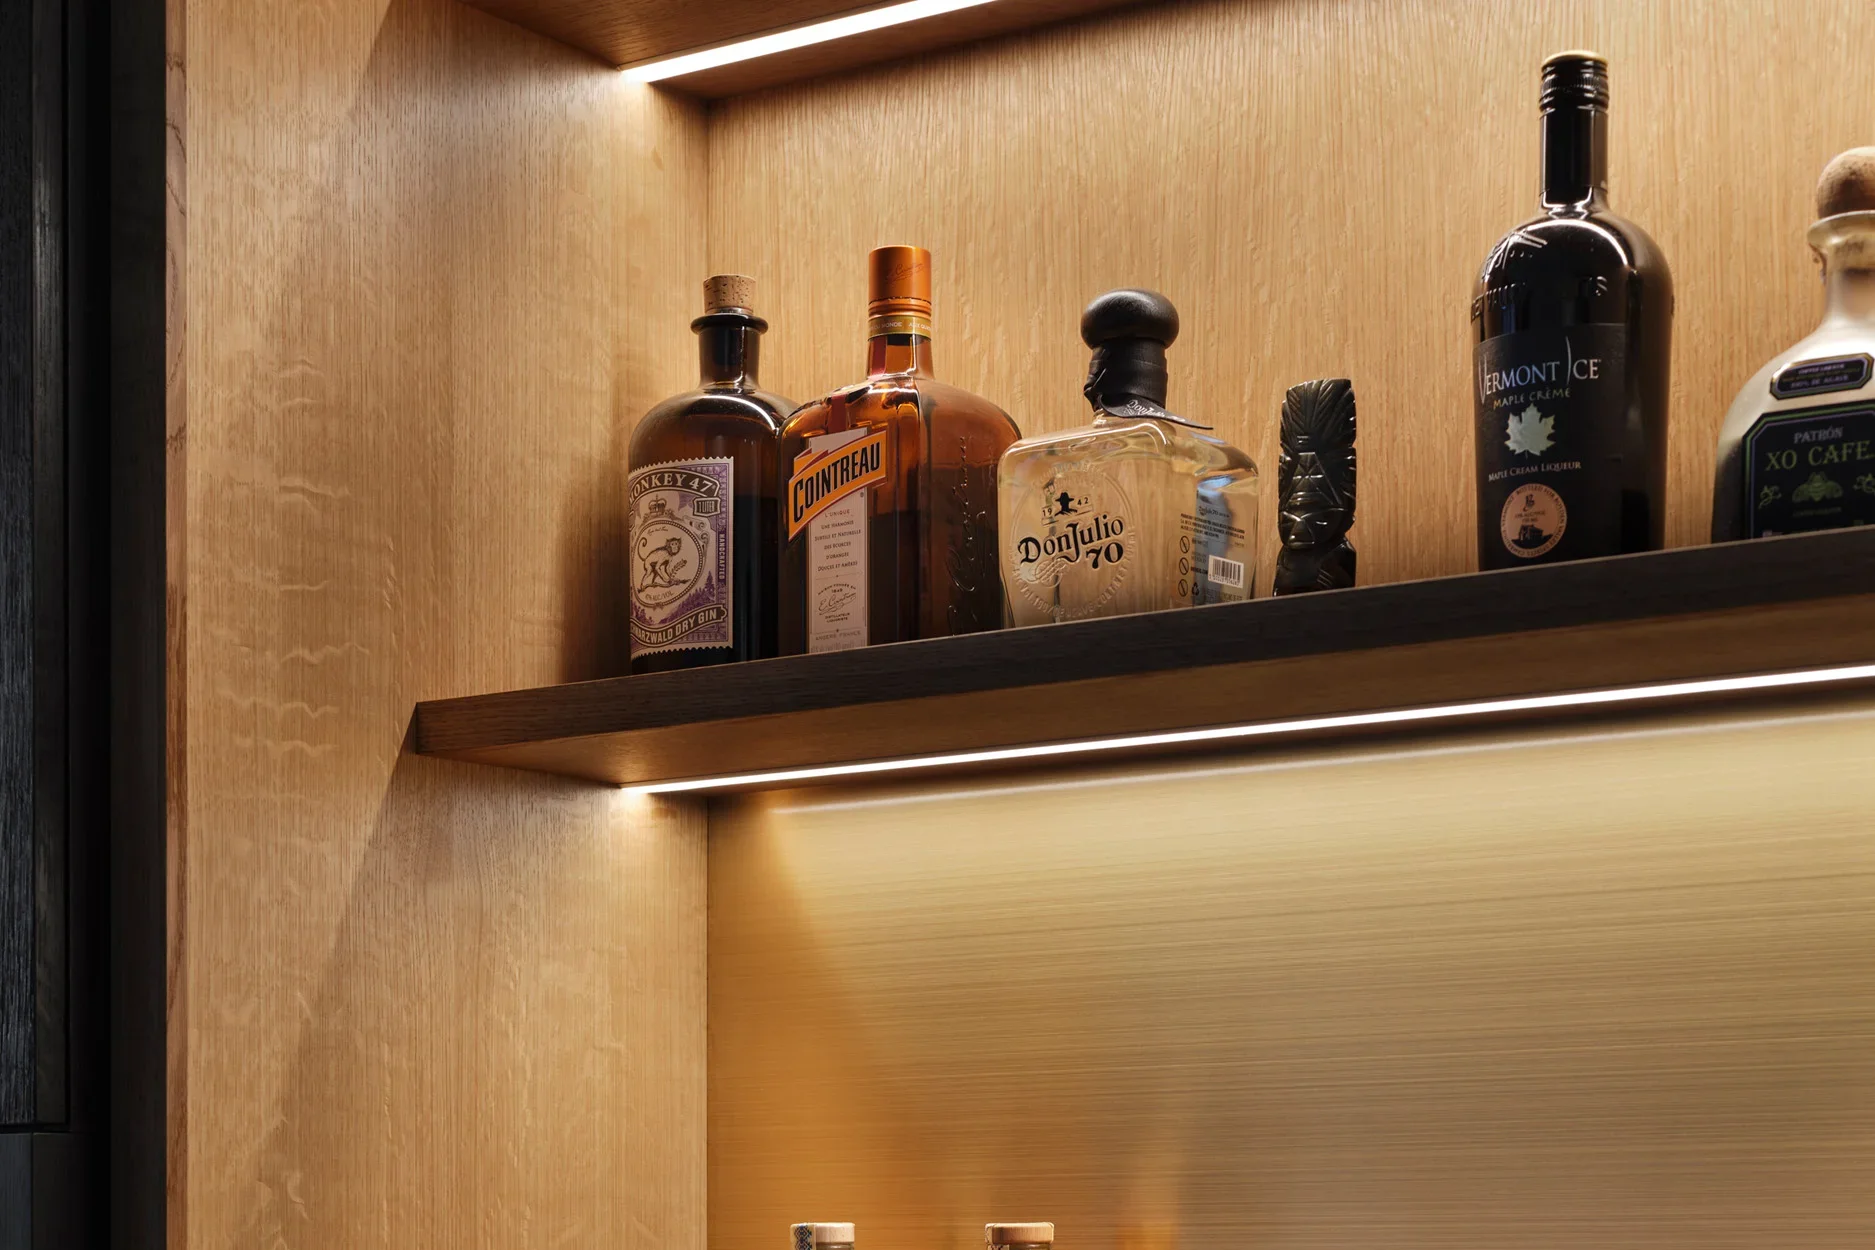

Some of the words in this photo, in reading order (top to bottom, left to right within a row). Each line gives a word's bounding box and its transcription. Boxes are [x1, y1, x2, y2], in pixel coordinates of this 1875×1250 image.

[1478, 353, 1560, 404] VERMONT
[1565, 336, 1600, 385] ICE
[1493, 392, 1526, 409] MAPLE
[1529, 387, 1572, 402] CRÈME
[1510, 466, 1538, 476] CREAM
[1541, 462, 1582, 473] LIQUEUR
[1766, 450, 1797, 471] XO
[689, 478, 713, 492] 47
[793, 442, 881, 524] COINTREAU
[1043, 508, 1053, 517] 19
[1077, 496, 1089, 506] 42
[718, 533, 726, 581] HANDCRAFTED
[1086, 542, 1124, 569] 70
[676, 616, 705, 637] DRY
[698, 608, 718, 623] GIN
